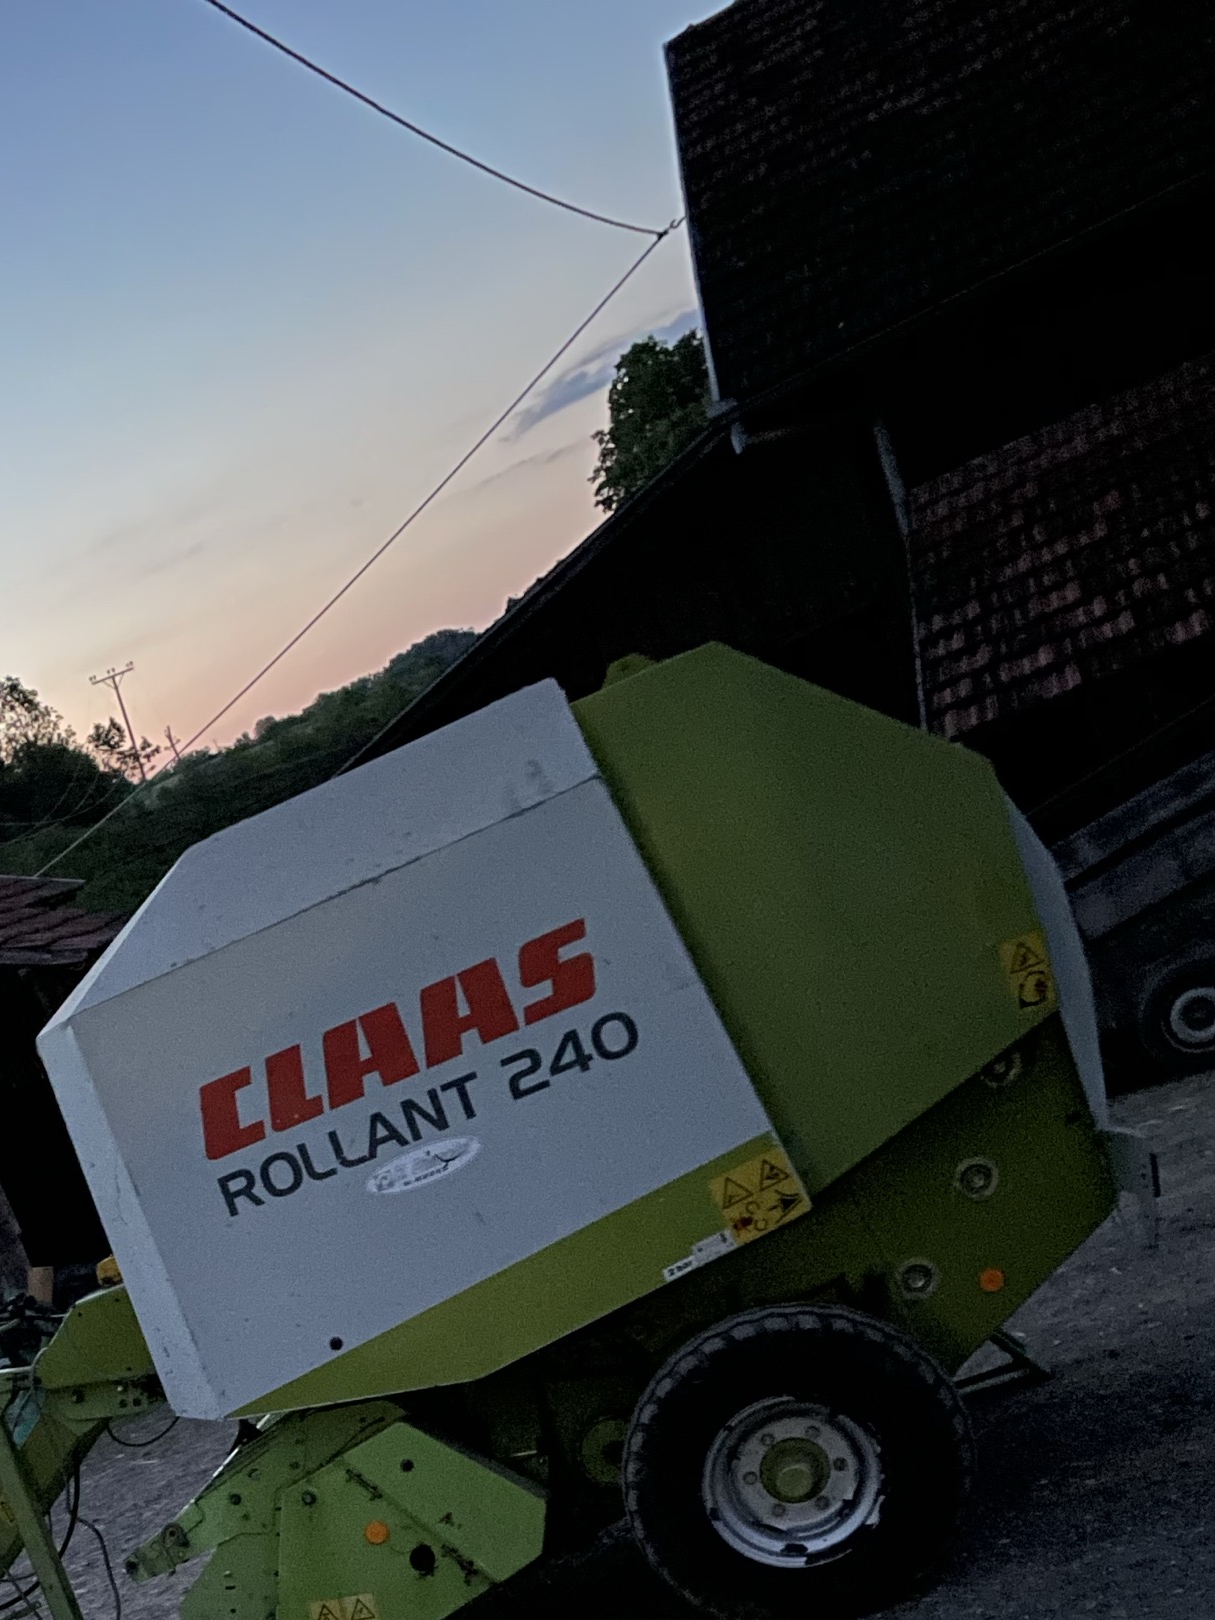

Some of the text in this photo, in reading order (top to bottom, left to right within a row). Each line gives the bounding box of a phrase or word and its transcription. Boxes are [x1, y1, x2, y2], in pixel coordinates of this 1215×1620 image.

[199, 918, 596, 1160] CLAAS
[218, 1012, 639, 1217] ROLLANT 240
